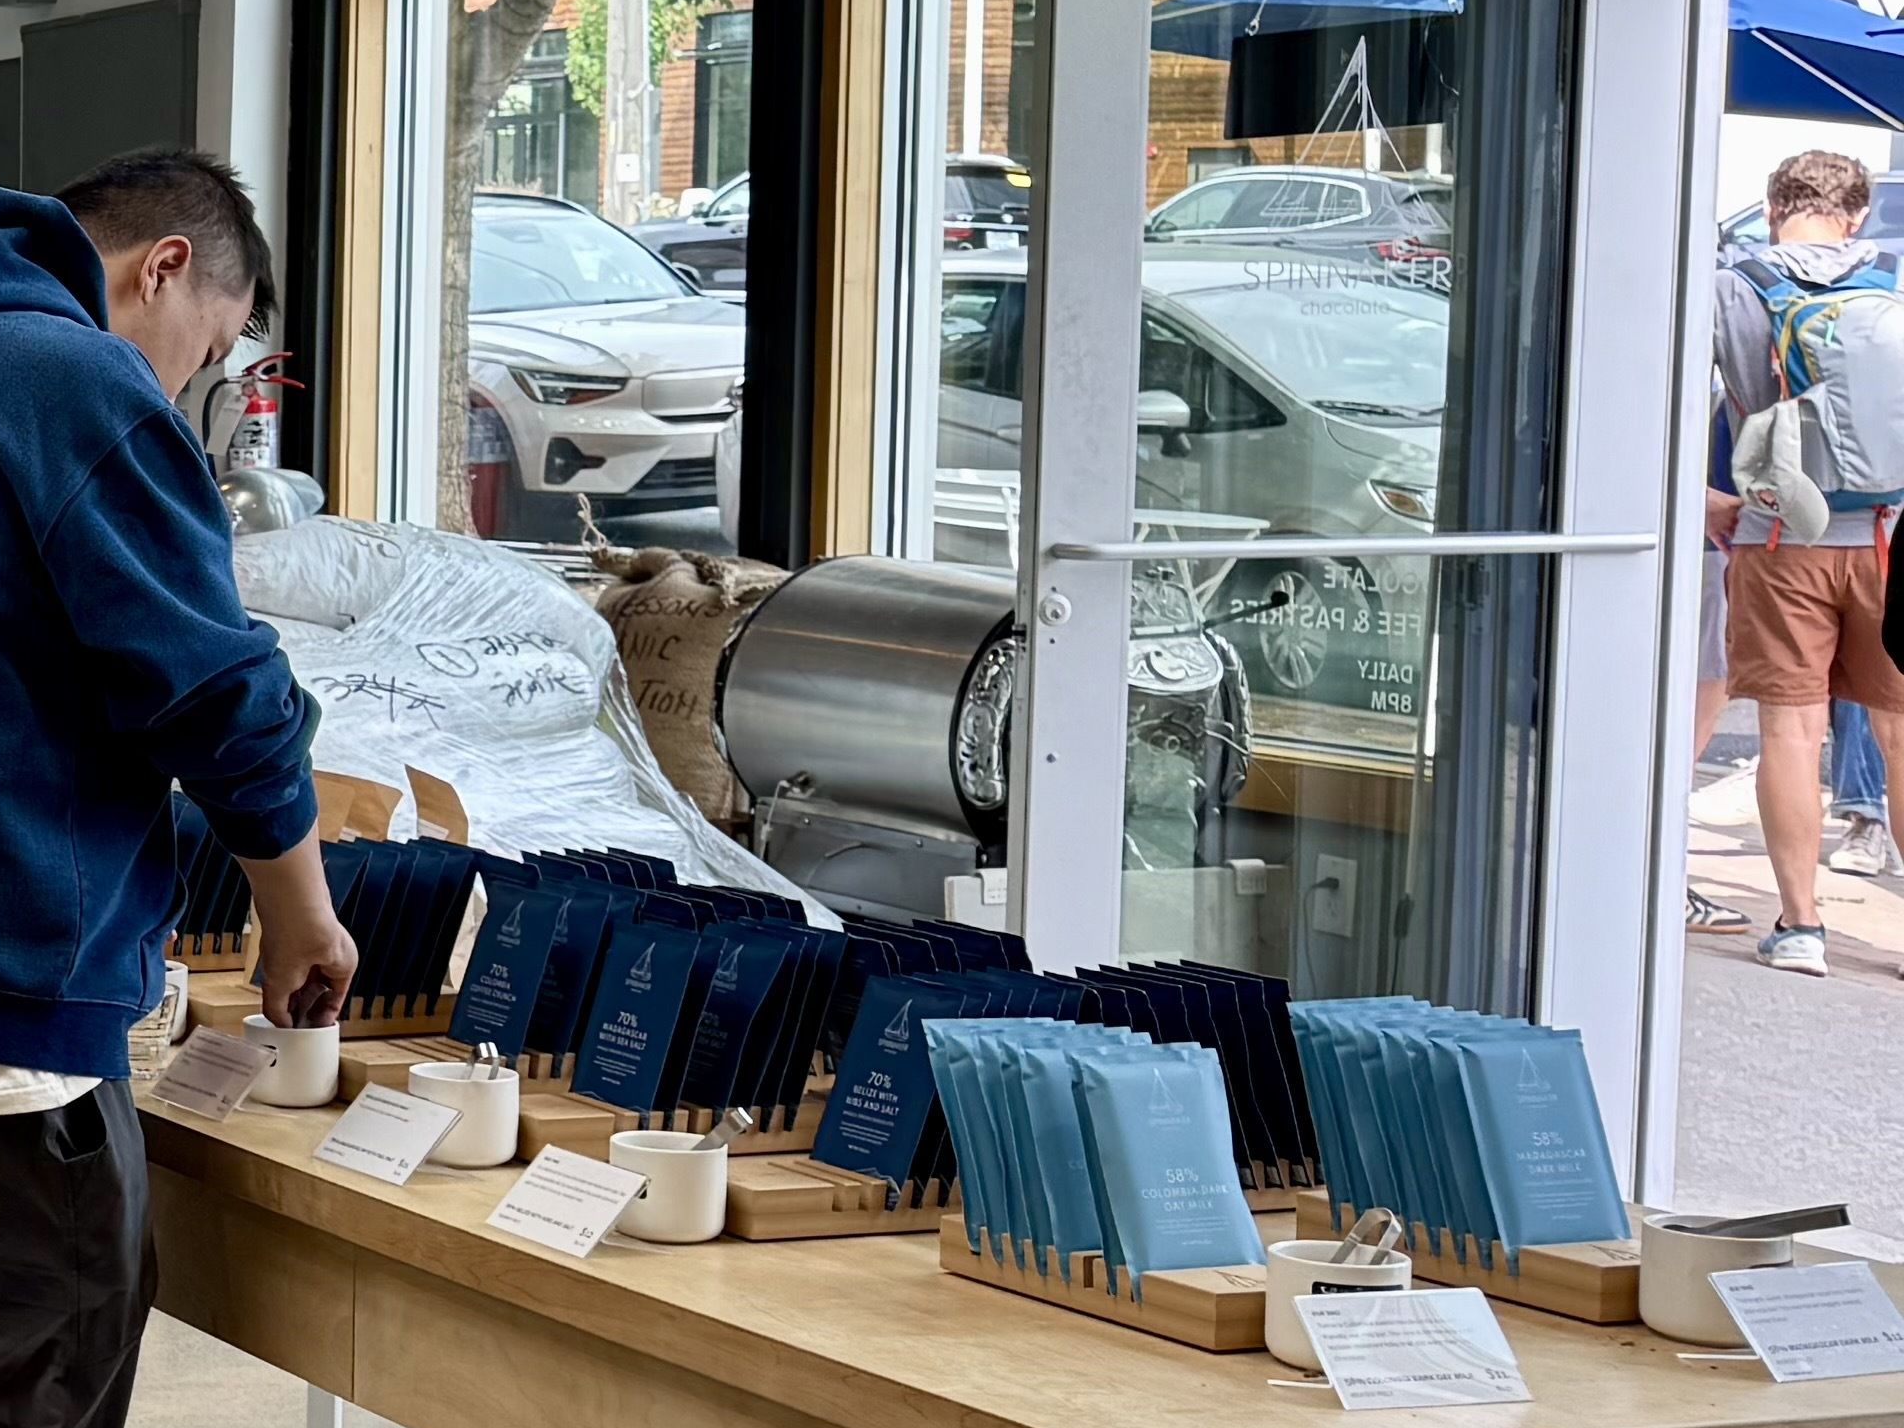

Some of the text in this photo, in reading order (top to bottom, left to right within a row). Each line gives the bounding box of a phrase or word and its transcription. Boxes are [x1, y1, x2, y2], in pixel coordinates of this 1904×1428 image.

[1243, 255, 1452, 291] SPINNAKER
[1300, 300, 1390, 316] chocolate
[490, 963, 509, 978] 70%
[617, 1011, 638, 1028] 70%
[602, 1023, 648, 1041] MADAGASCAR
[599, 1032, 647, 1051] WITH SEA SALT
[867, 1071, 892, 1089] 70%
[853, 1084, 899, 1103] BELIZE WITH
[845, 1095, 900, 1116] NIBS AND SALT
[1532, 1132, 1564, 1146] 58%
[1516, 1147, 1586, 1160] MADAGASCAR
[1165, 1168, 1199, 1184] 58%
[1141, 1183, 1229, 1200] COLOMBIA DARK
[1163, 1200, 1213, 1212] OAT MILK
